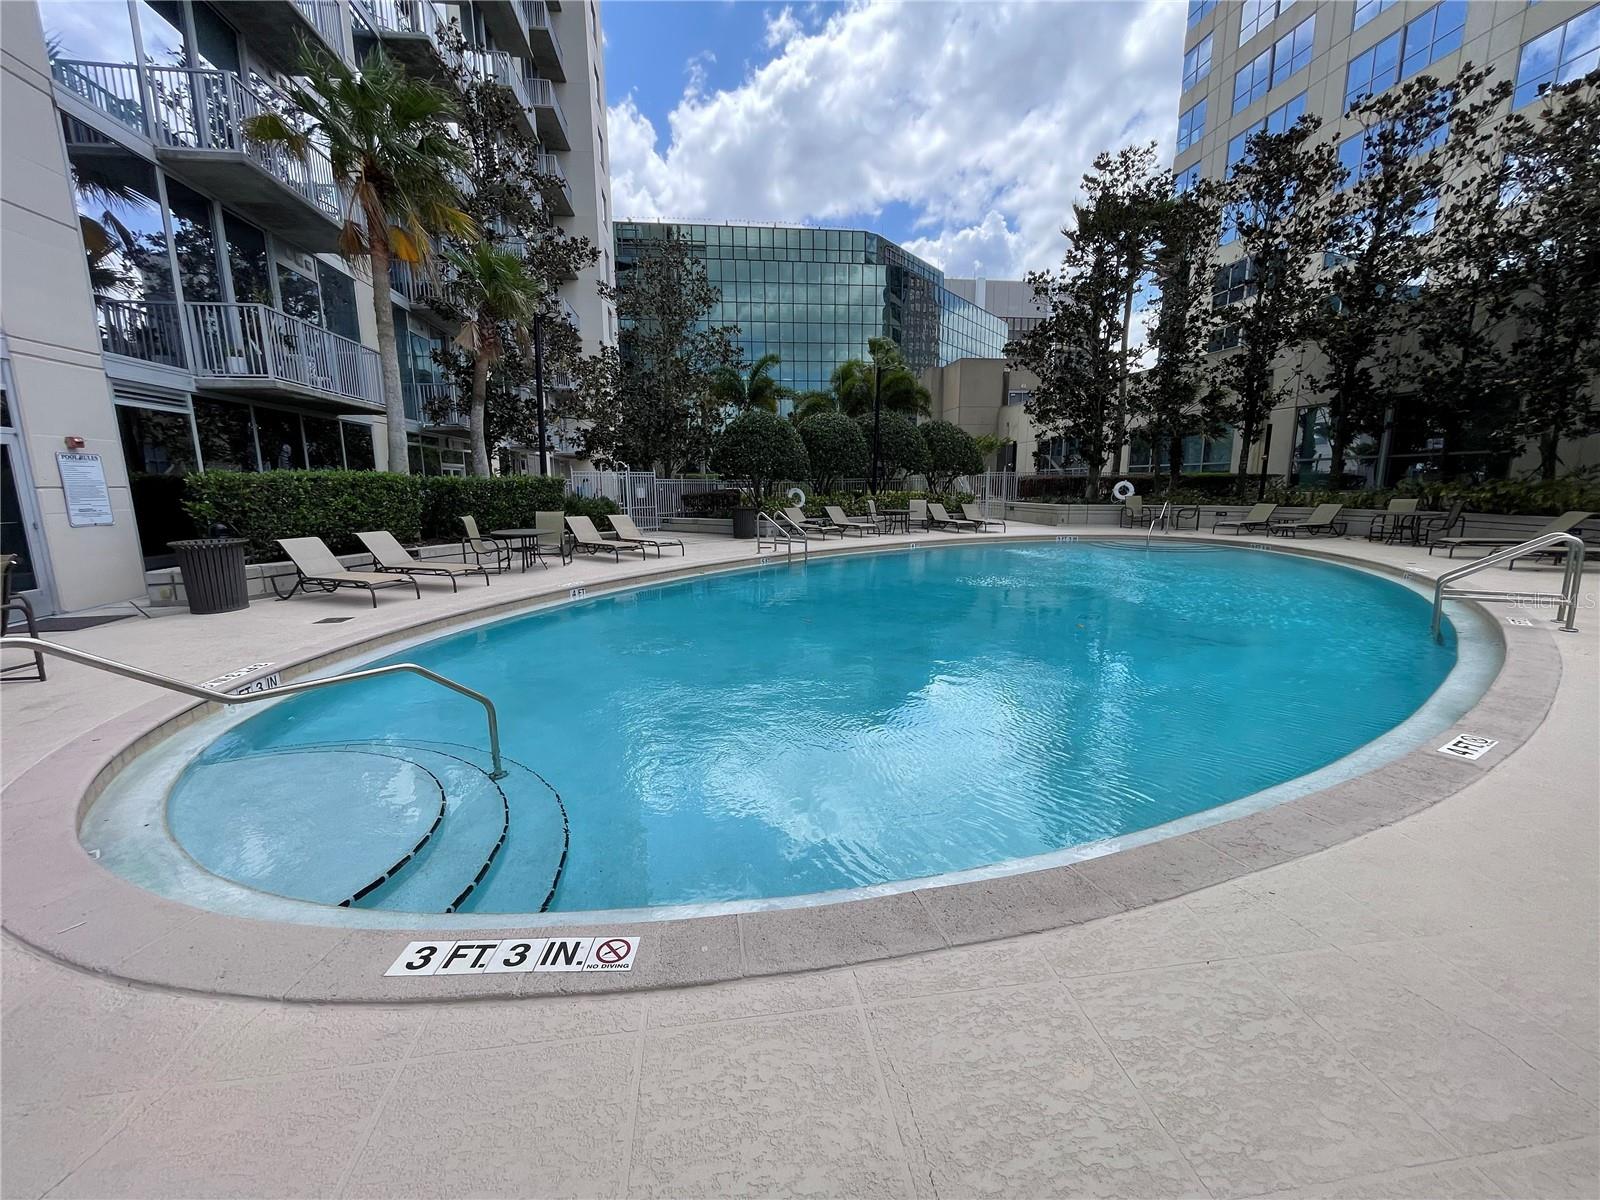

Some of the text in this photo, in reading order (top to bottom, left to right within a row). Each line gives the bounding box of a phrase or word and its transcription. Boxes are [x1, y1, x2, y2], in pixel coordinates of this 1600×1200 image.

[256, 682, 264, 691] 3
[405, 941, 583, 970] 3 FT. 3 IN.
